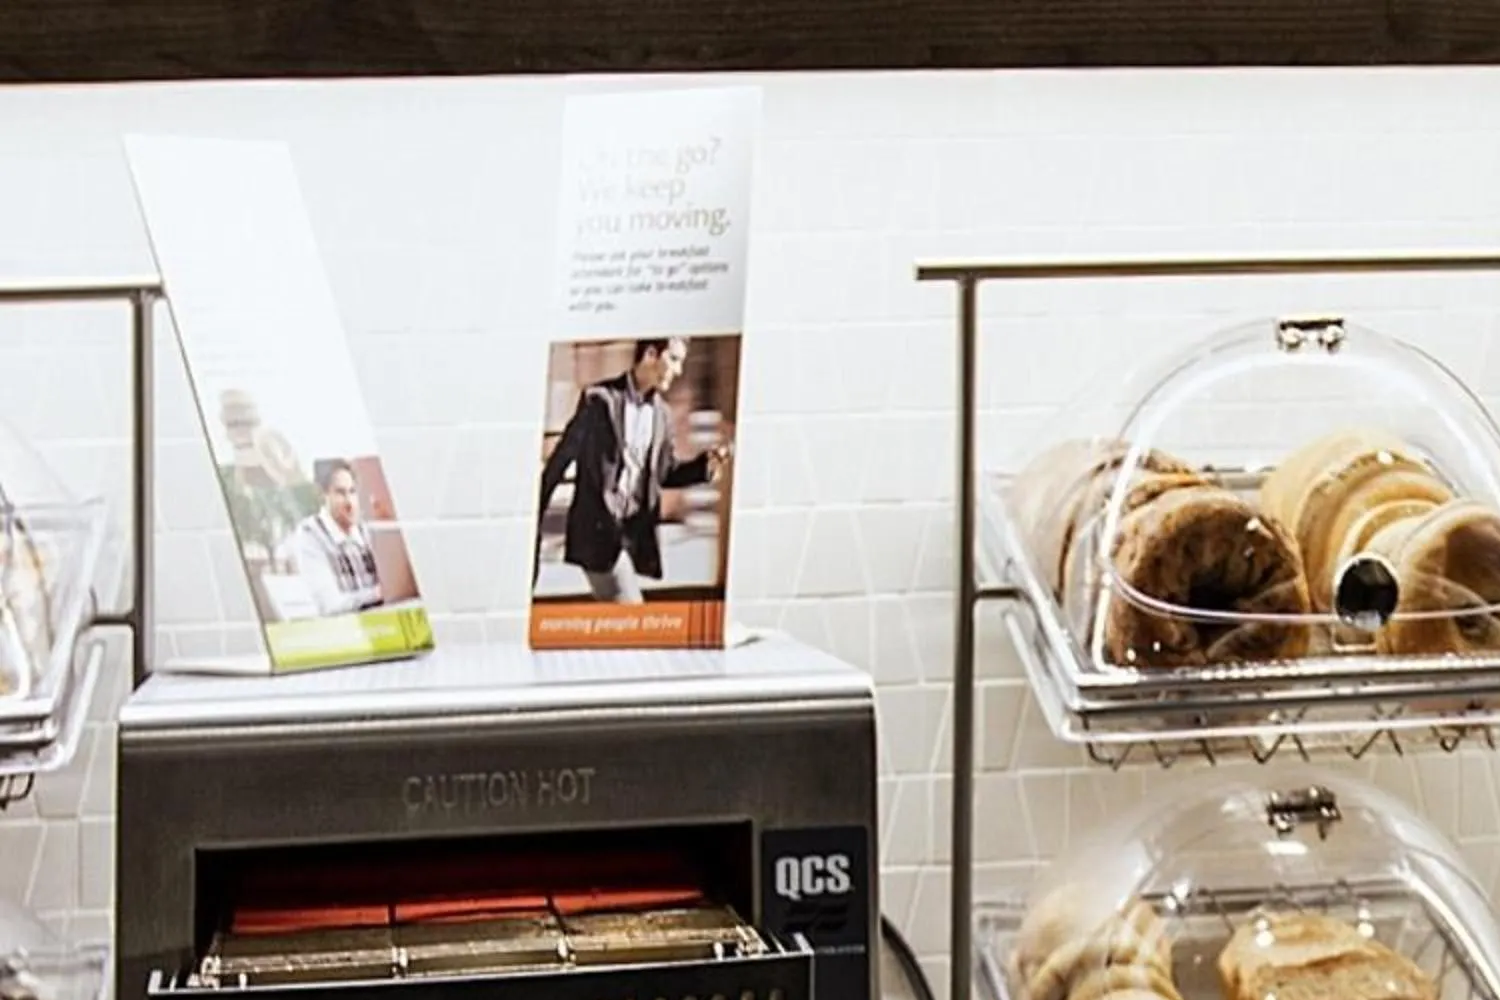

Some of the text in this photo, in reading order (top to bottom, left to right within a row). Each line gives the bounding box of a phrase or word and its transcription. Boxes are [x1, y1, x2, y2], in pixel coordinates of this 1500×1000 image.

[675, 134, 722, 175] go?
[629, 203, 732, 237] moving.
[403, 767, 596, 812] CAUTION HOT
[775, 854, 851, 901] QCS
